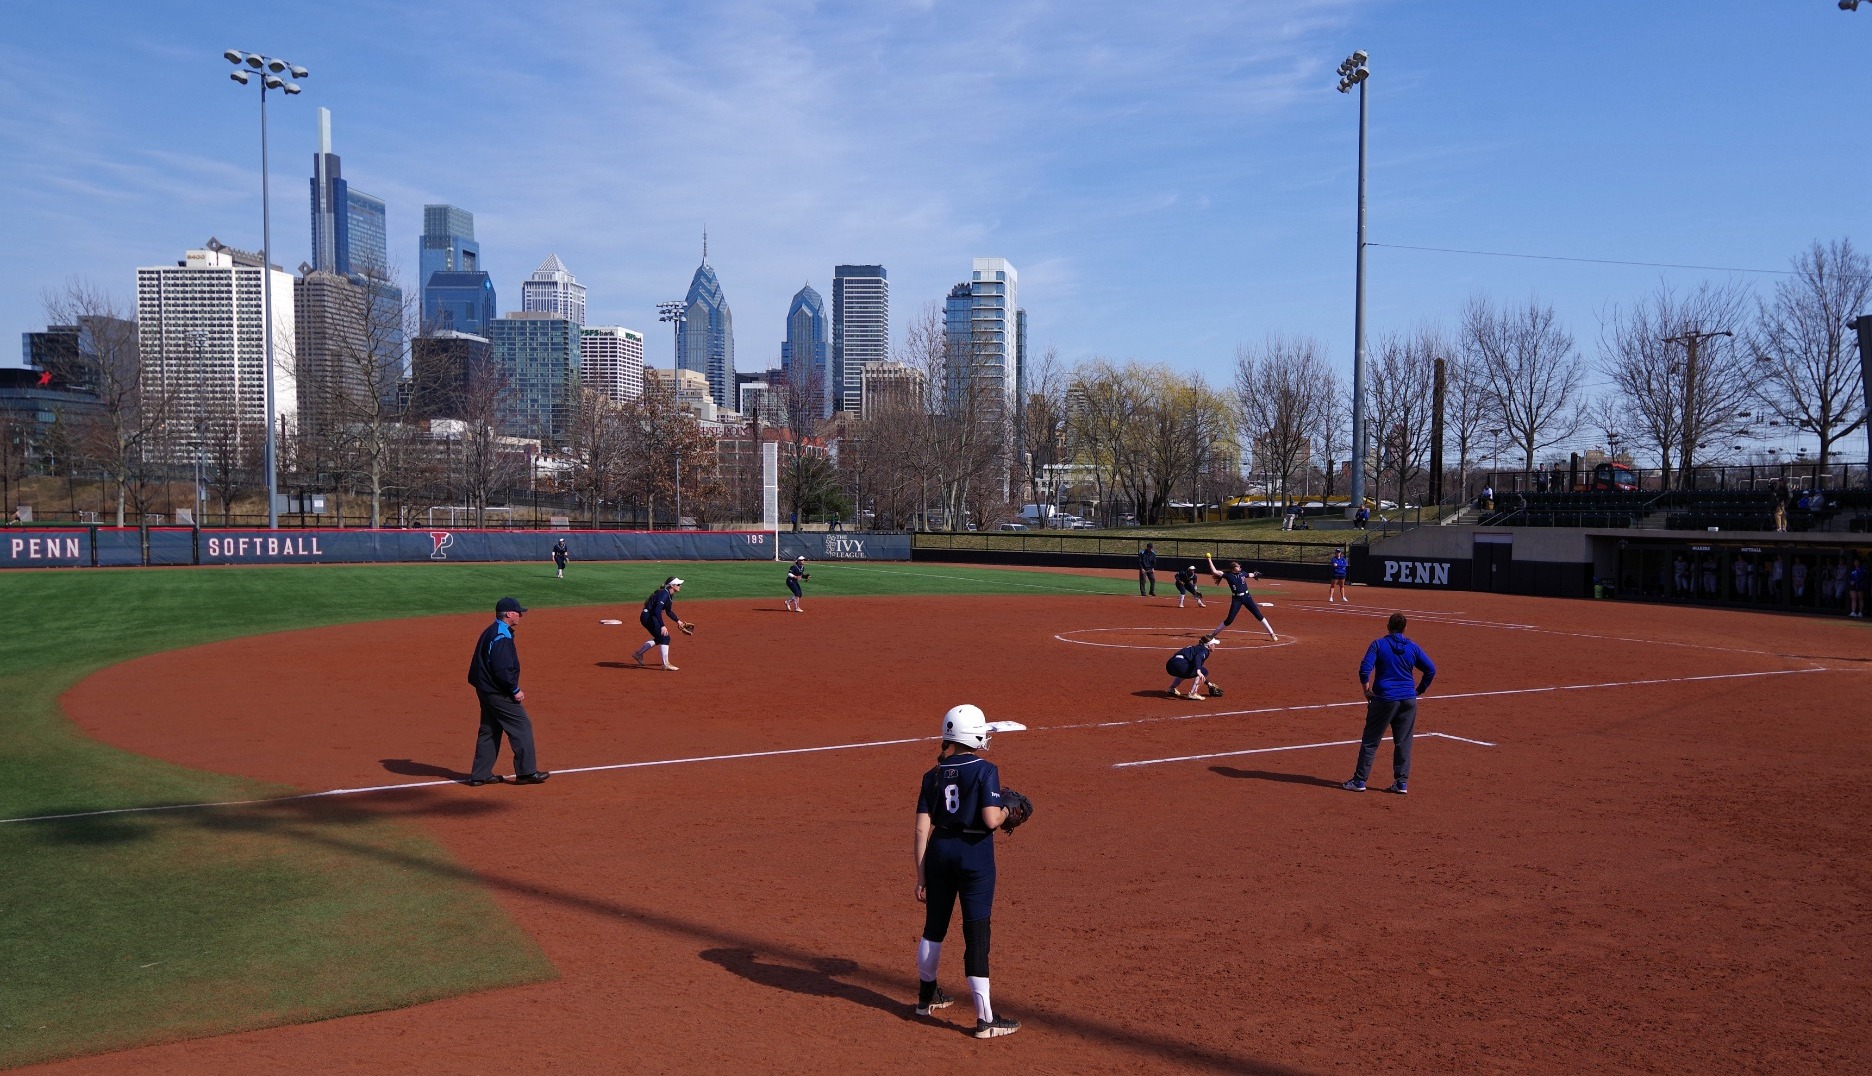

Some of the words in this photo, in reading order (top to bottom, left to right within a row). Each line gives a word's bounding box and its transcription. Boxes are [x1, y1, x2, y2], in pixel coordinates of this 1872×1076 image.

[11, 538, 79, 558] PENN
[208, 537, 323, 556] SOFTBALL
[430, 531, 454, 559] P
[836, 539, 864, 552] IVY
[1383, 560, 1451, 585] PENN
[945, 784, 960, 814] 8
